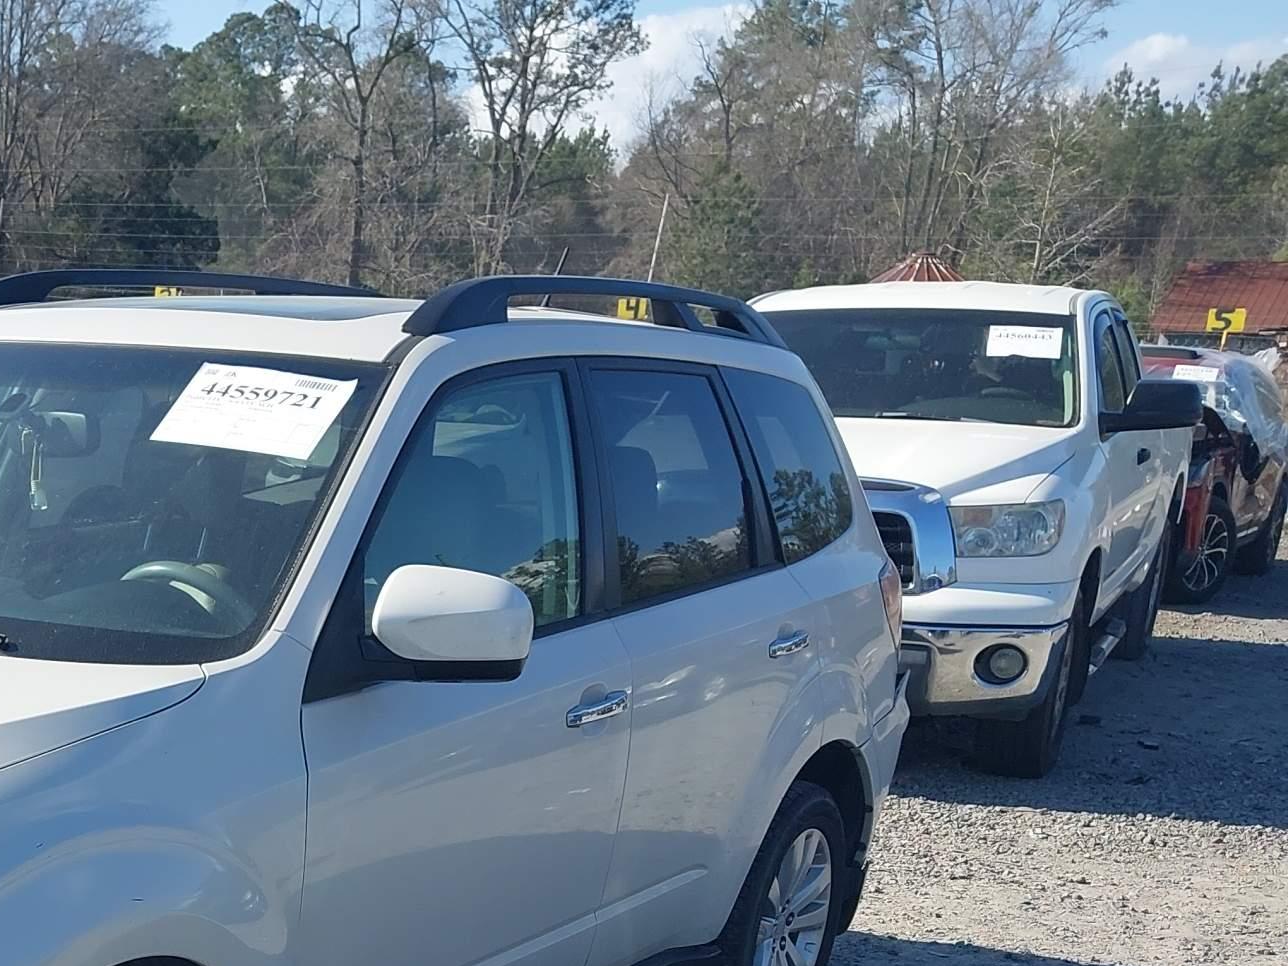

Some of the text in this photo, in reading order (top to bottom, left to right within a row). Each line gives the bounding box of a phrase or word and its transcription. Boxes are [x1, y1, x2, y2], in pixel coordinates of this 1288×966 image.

[625, 297, 640, 320] 4
[1210, 305, 1233, 331] 5
[201, 381, 323, 409] 44559721
